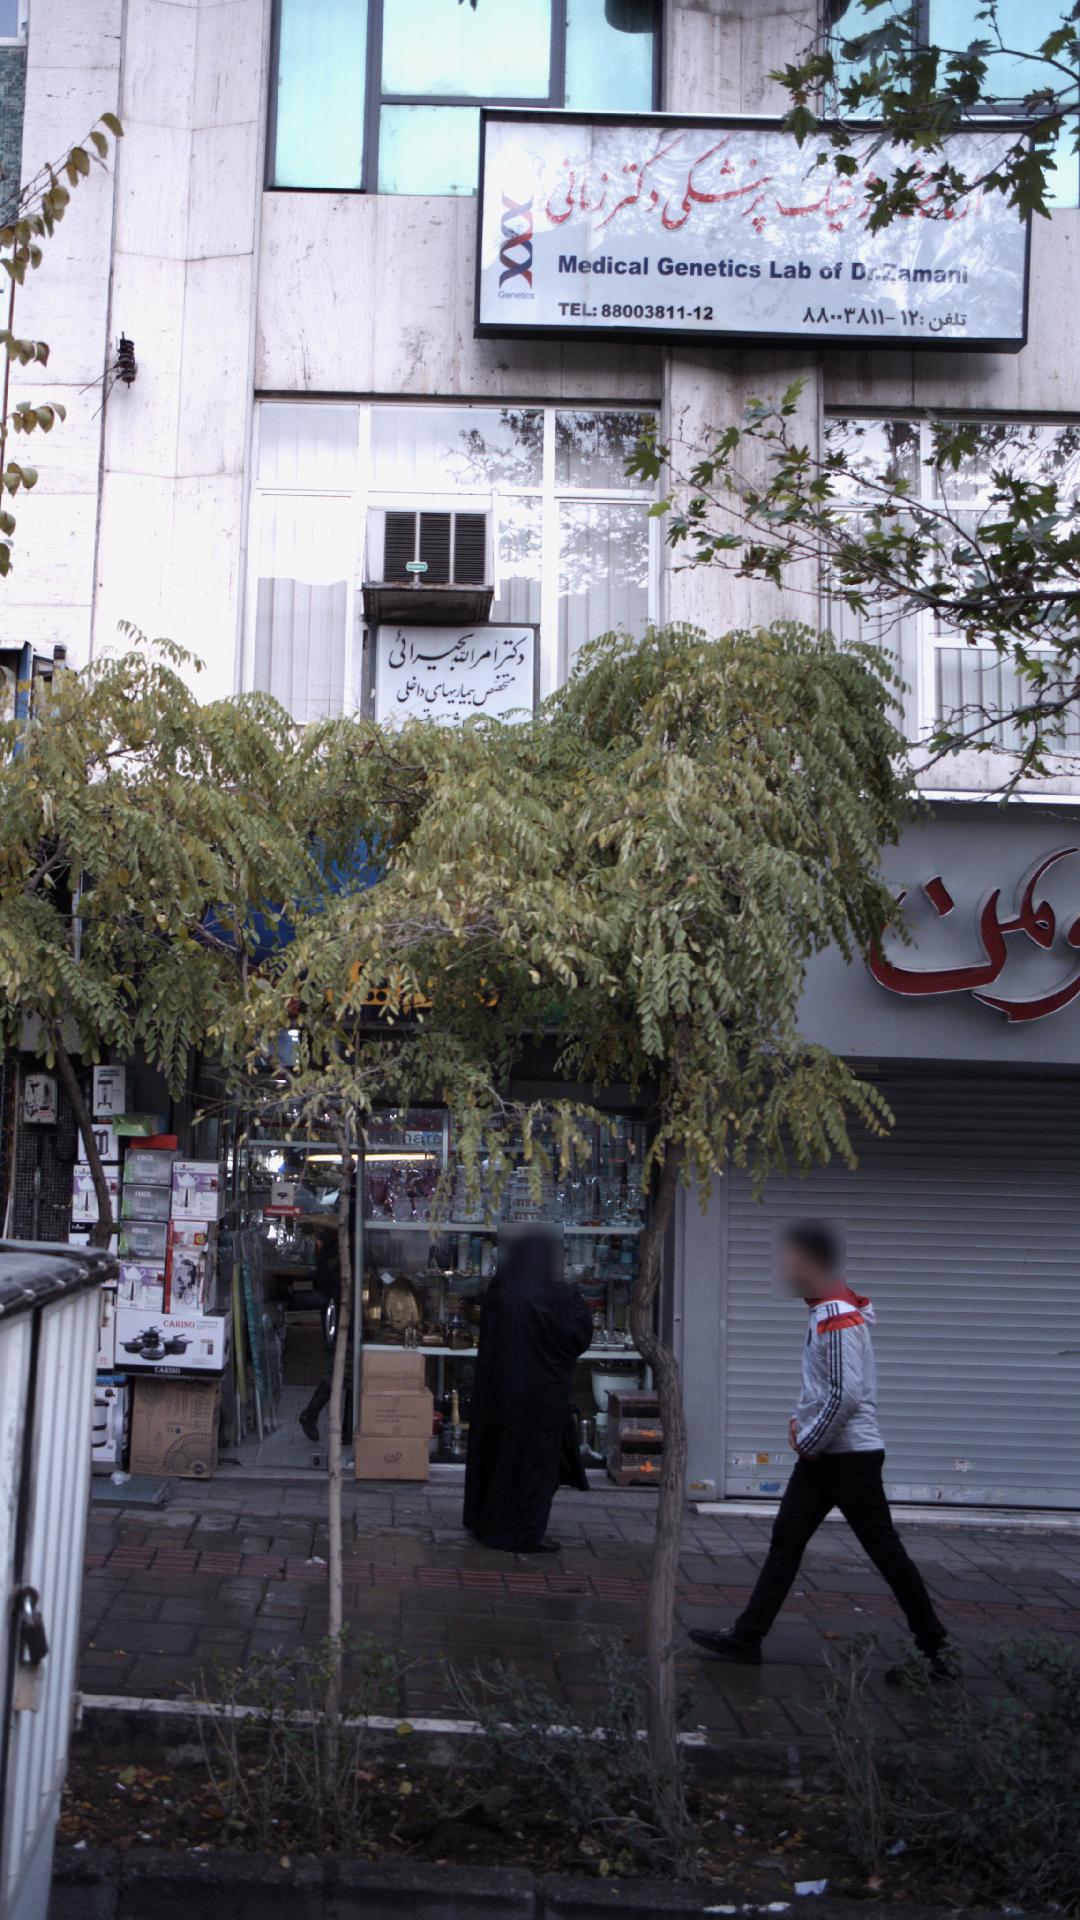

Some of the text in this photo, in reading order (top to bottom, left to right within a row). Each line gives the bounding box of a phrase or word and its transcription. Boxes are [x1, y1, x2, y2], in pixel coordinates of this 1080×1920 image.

[594, 133, 688, 230] دکتر
[558, 254, 649, 275] Medical
[657, 258, 761, 278] Genetics
[769, 260, 812, 279] Lab
[819, 262, 843, 280] of
[498, 290, 535, 300] Genetics
[558, 302, 713, 320] TEL: 88003811-12
[494, 636, 528, 670] دکتر
[396, 676, 425, 703] داخلی
[472, 673, 516, 706] متخصص
[163, 1319, 196, 1329] CARINO
[154, 1366, 181, 1374] CARINO
